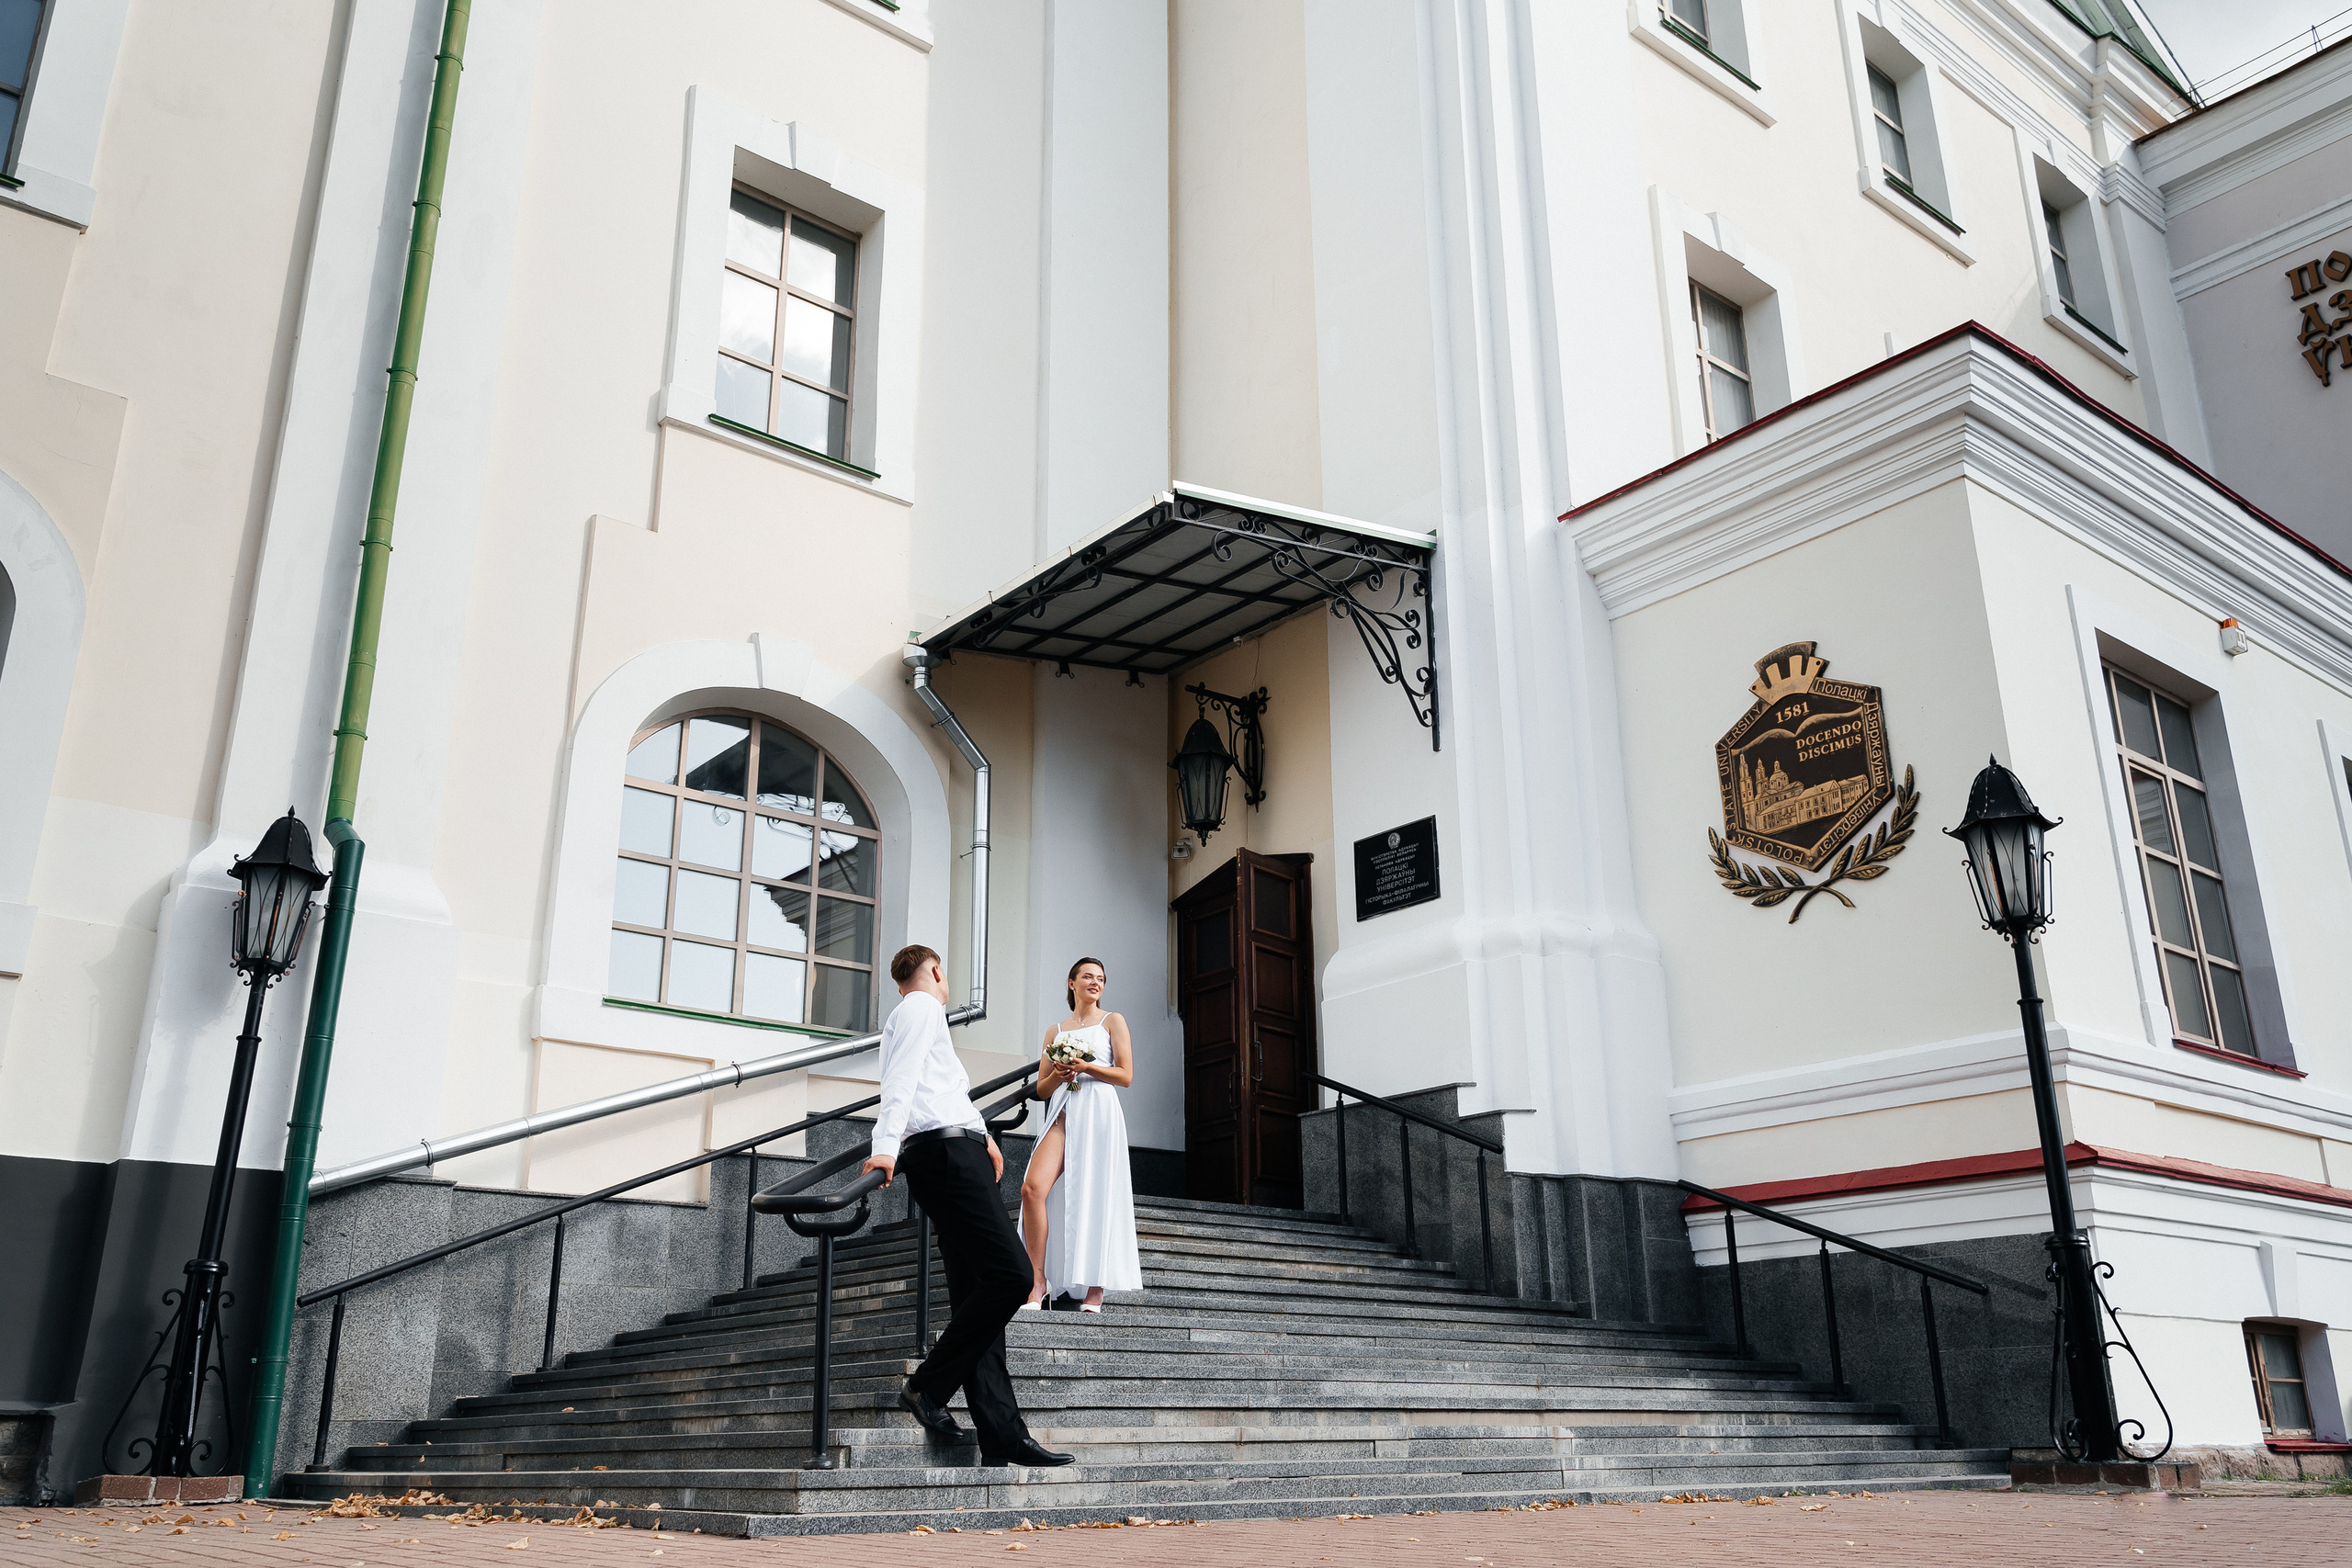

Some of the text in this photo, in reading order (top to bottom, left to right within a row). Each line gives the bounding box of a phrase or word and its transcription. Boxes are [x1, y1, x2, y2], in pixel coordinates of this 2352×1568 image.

[1815, 679, 1868, 701] Полацкі
[1775, 701, 1810, 724] 1581
[1795, 719, 1862, 750] DOCENDO
[1798, 733, 1862, 762] DISCIMUS
[1716, 705, 1804, 864] POLOTSK STATE UNIVERSITY
[1819, 794, 1883, 855] Універсітэт
[1375, 868, 1416, 886] ДЗЯРЖАЎНЫ
[1382, 862, 1408, 875] ПОЛАЦКІ
[1376, 875, 1416, 893] УНІВЕРСІТЭТ
